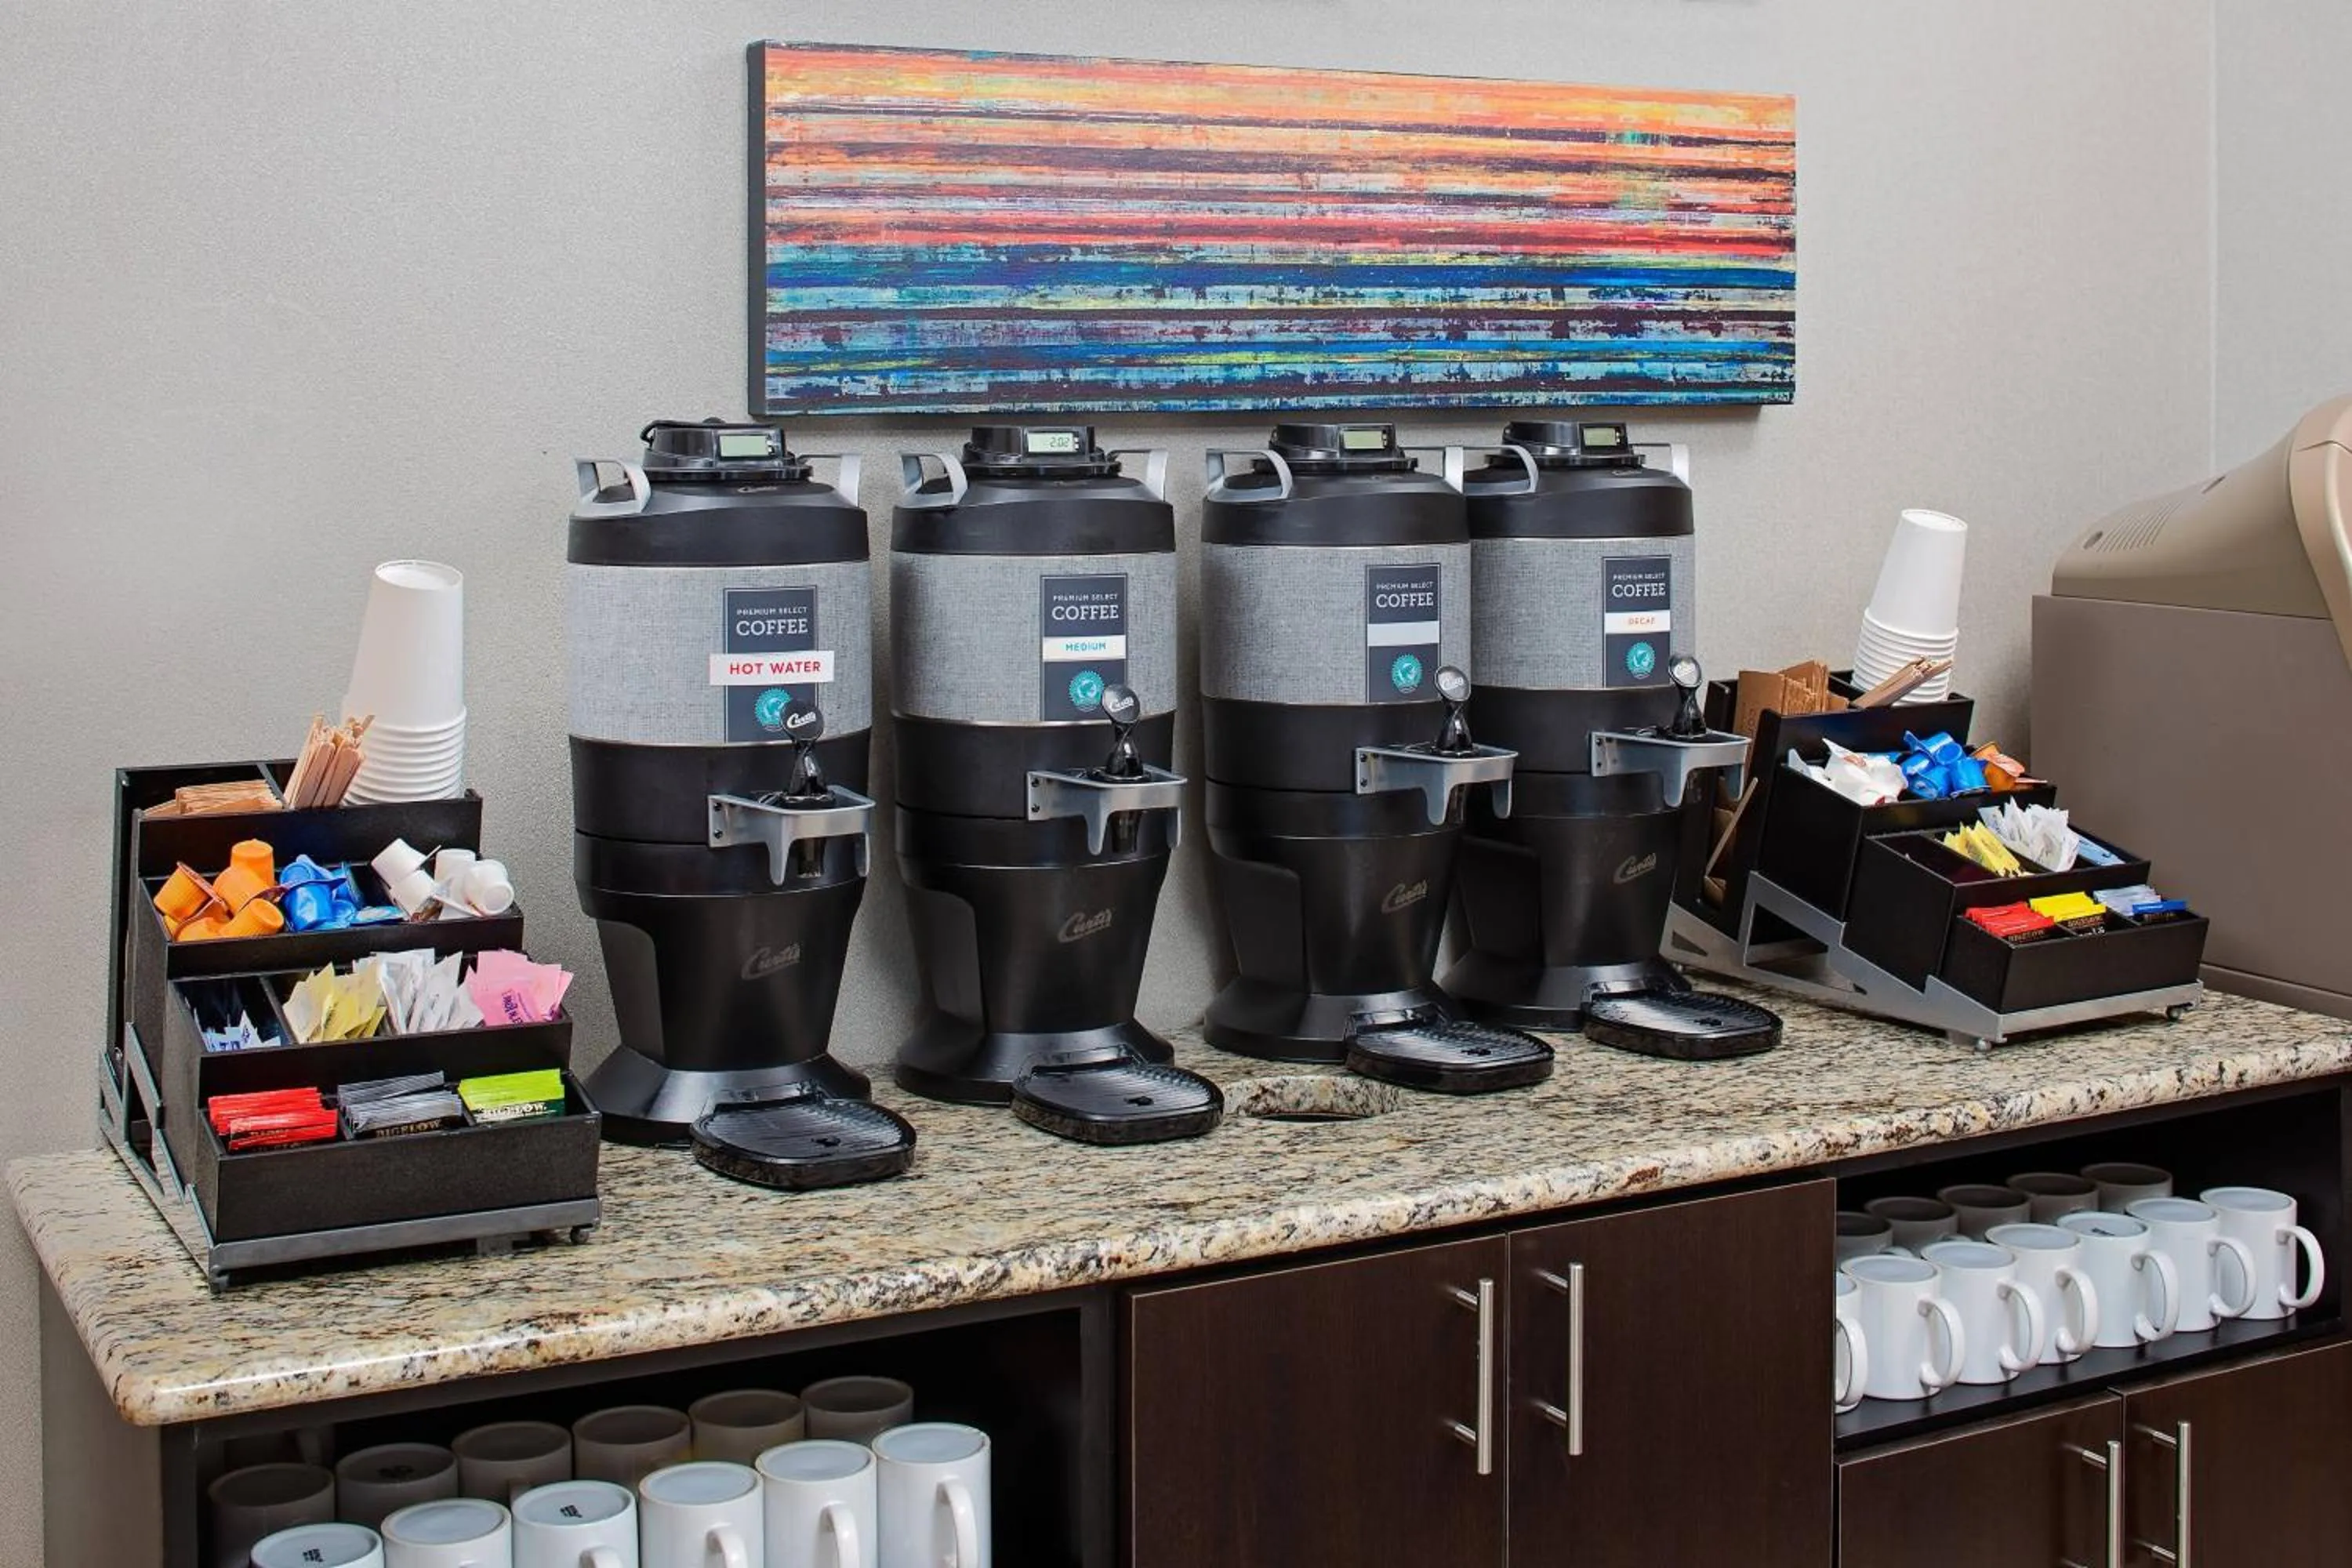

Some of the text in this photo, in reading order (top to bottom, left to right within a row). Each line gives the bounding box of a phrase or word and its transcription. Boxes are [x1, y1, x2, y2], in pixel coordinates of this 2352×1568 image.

[1612, 583, 1666, 598] COFFEE
[1376, 592, 1434, 608] COFFEE
[736, 606, 808, 615] PREMIUM SELECT
[1051, 604, 1119, 620] COFFEE
[736, 619, 808, 636] COFFEE
[1065, 642, 1106, 652] MEDIUM
[729, 661, 821, 675] HOT WATER
